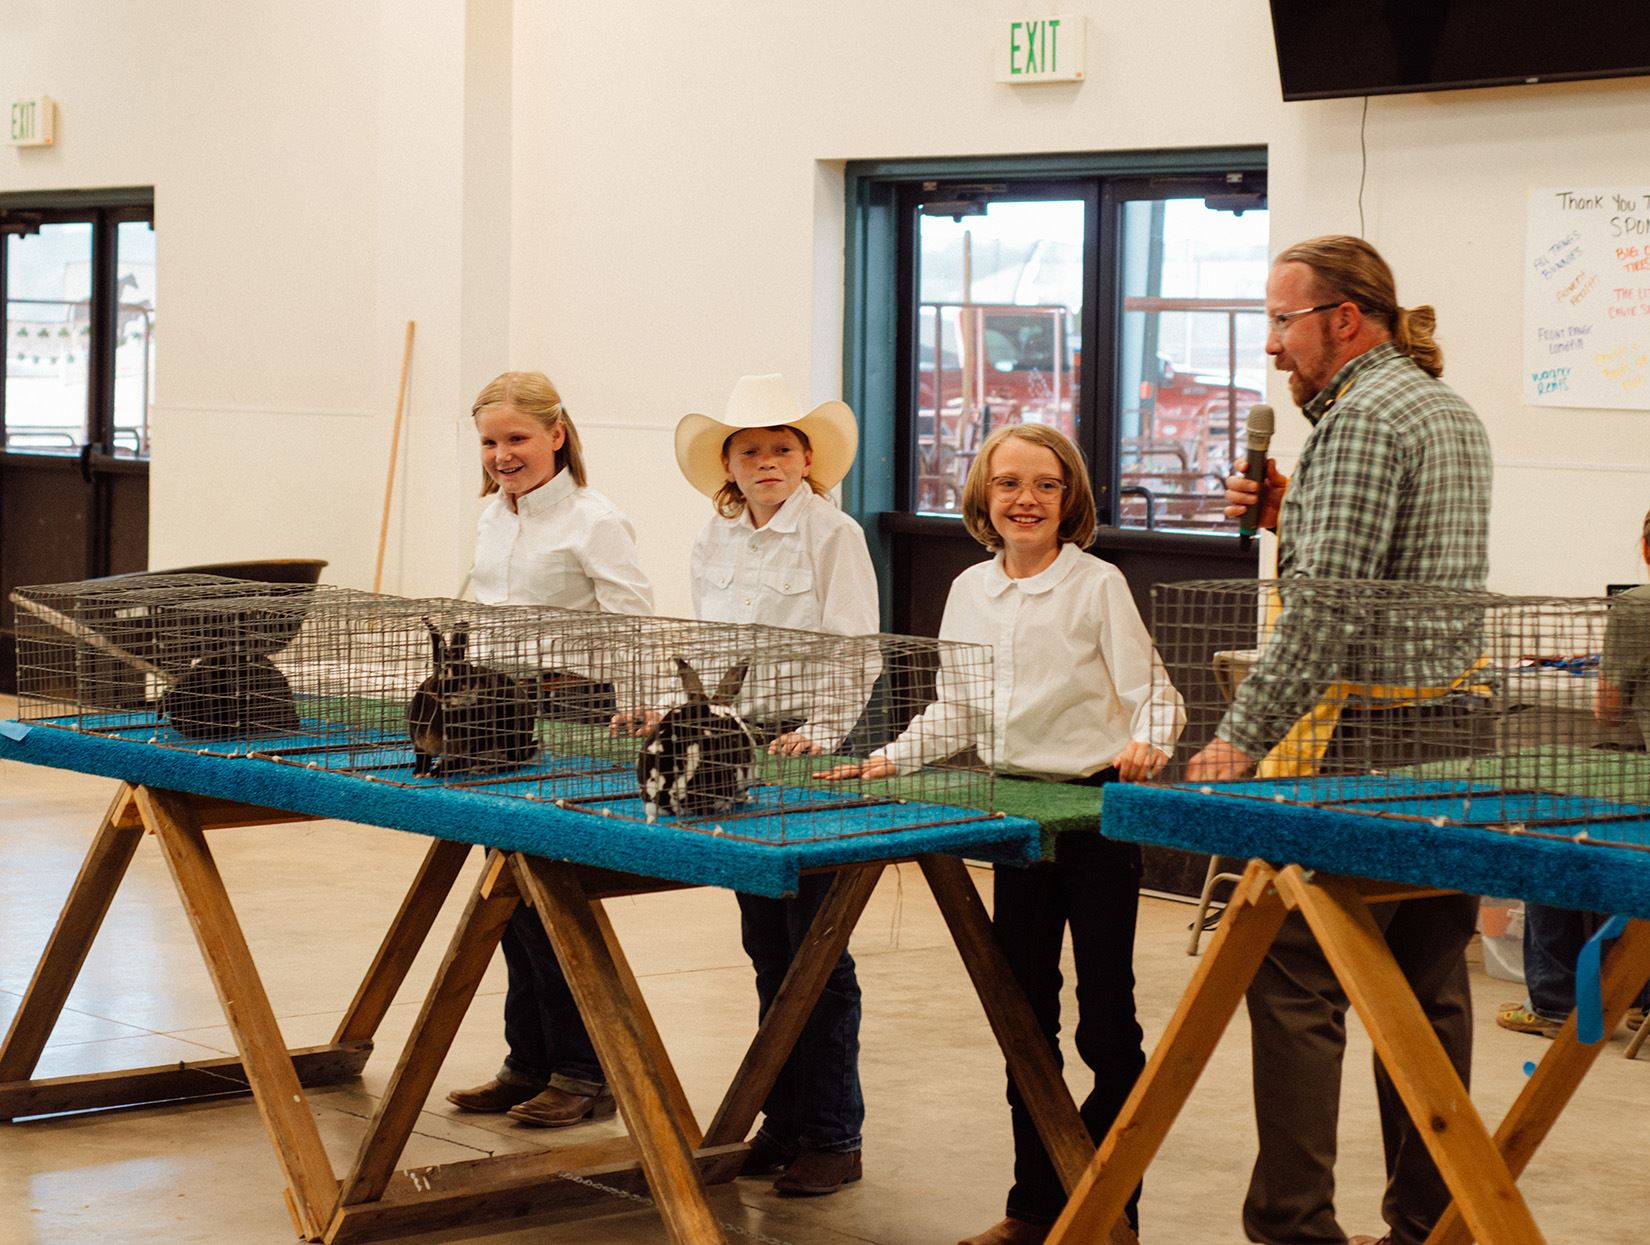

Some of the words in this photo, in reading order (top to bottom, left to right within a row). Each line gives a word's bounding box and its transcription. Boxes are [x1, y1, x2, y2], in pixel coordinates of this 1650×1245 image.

[1011, 20, 1060, 74] EXIT
[11, 101, 36, 140] EXIT
[1556, 192, 1603, 210] Thank
[1612, 195, 1636, 211] You
